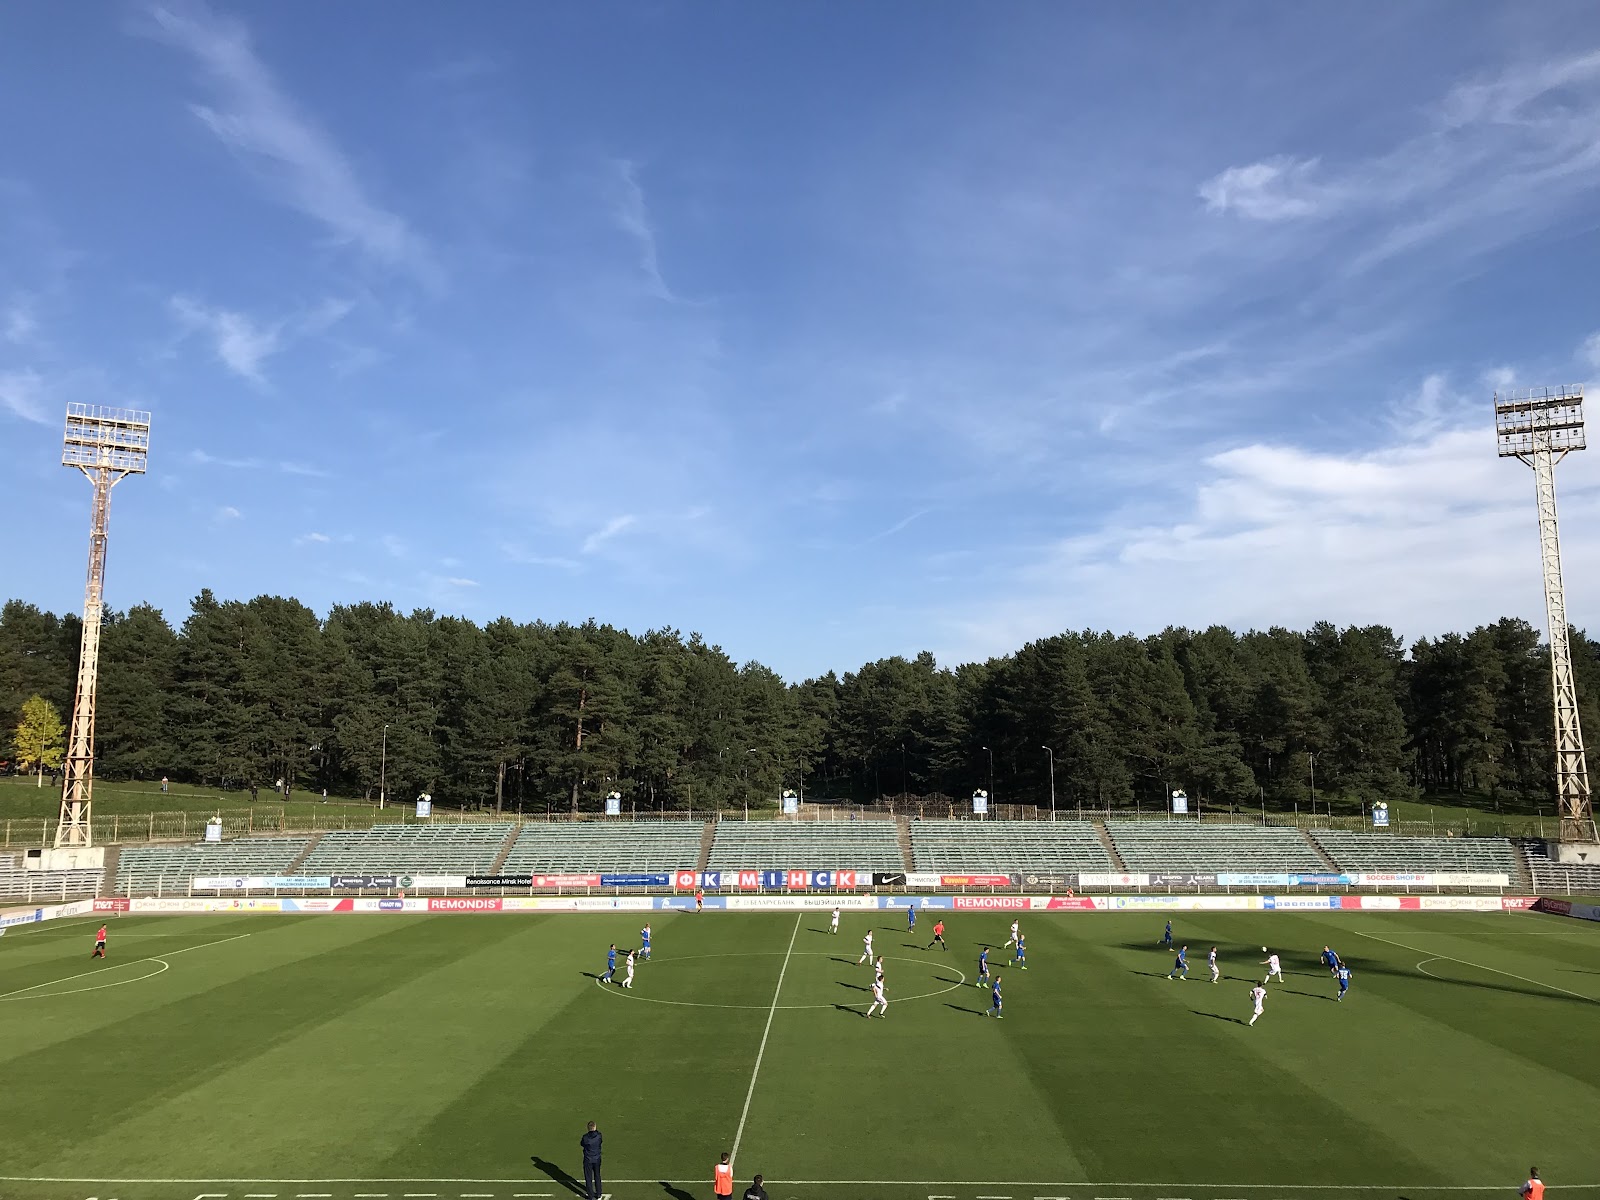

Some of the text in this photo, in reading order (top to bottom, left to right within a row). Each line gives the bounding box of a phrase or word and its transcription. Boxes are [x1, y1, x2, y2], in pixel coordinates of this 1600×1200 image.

[1375, 811, 1387, 819] 19
[679, 873, 717, 886] ФК
[94, 901, 114, 909] T&T
[431, 900, 496, 909] REMONDIS
[957, 898, 1024, 907] REMONDIS
[1503, 899, 1524, 907] T&T
